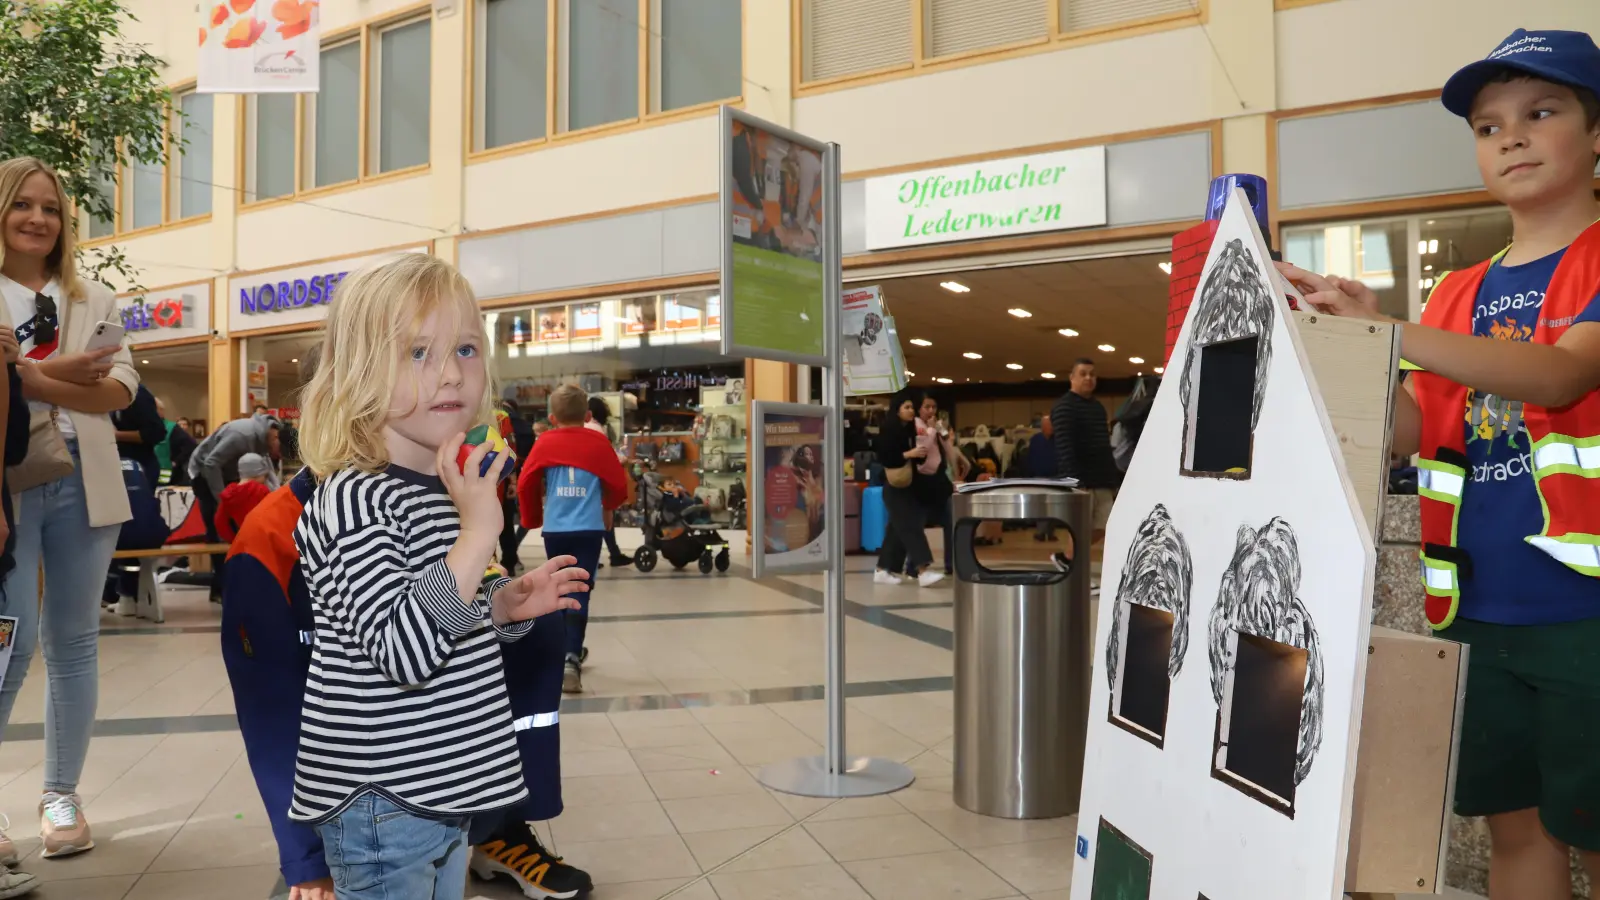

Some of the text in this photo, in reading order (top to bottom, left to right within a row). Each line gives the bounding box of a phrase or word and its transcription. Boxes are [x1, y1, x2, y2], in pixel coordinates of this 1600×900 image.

[898, 163, 1067, 209] Offenbacher
[903, 202, 1063, 239] Lederwaren
[556, 486, 588, 497] NEUER
